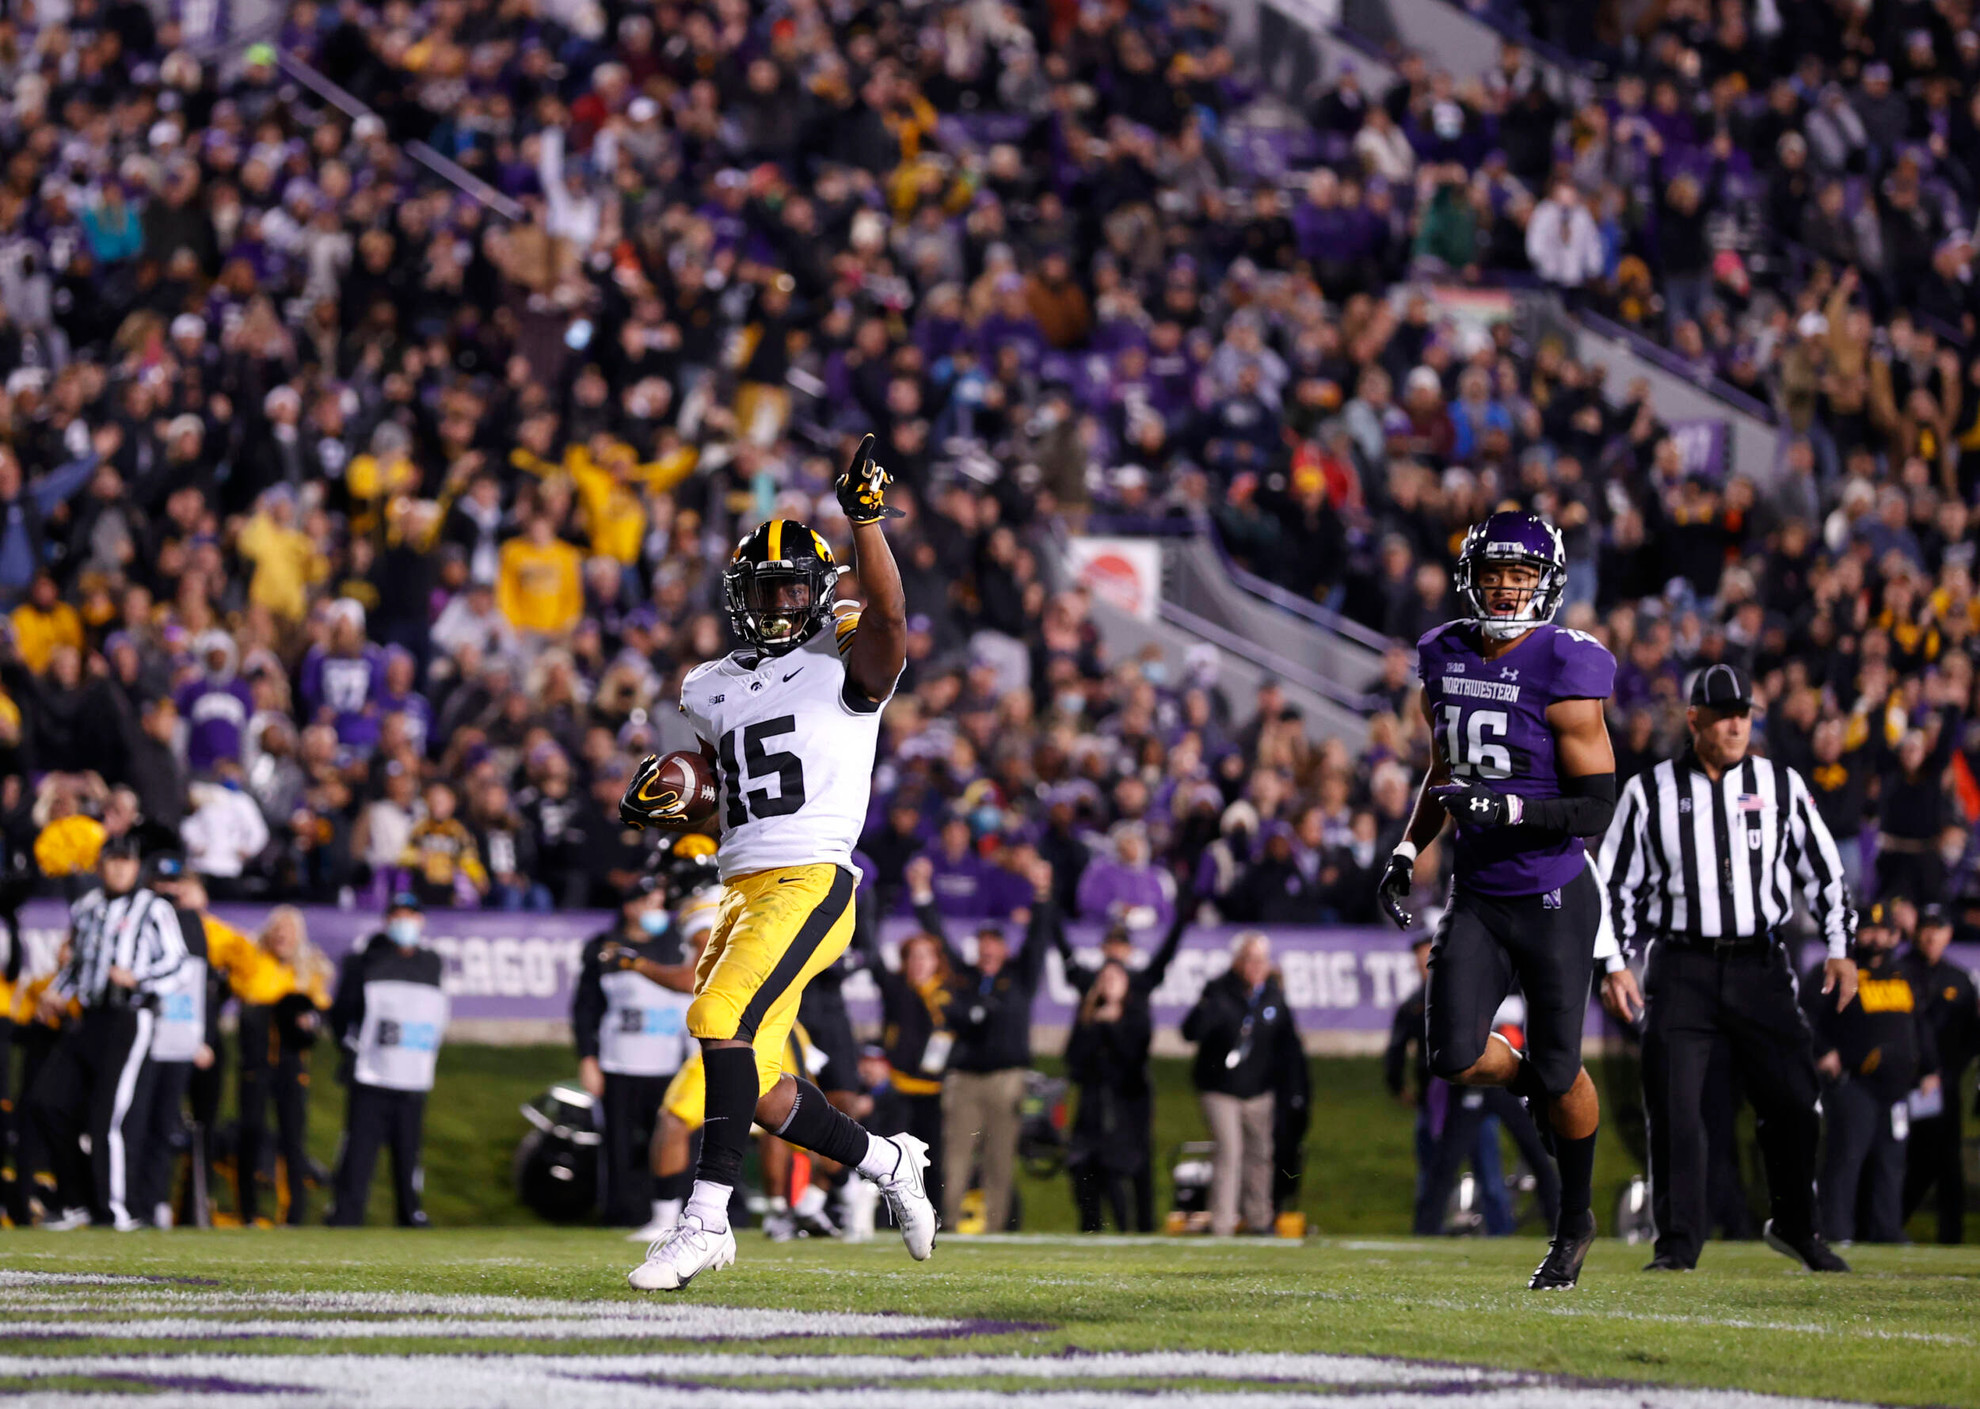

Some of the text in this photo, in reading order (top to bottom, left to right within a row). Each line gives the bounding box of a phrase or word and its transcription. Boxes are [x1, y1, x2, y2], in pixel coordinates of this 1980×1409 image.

[1442, 676, 1520, 703] NORTHWESTERN
[1445, 705, 1513, 780] 16
[719, 714, 806, 829] 15
[1748, 829, 1761, 850] U
[1280, 951, 1359, 1008] BIG
